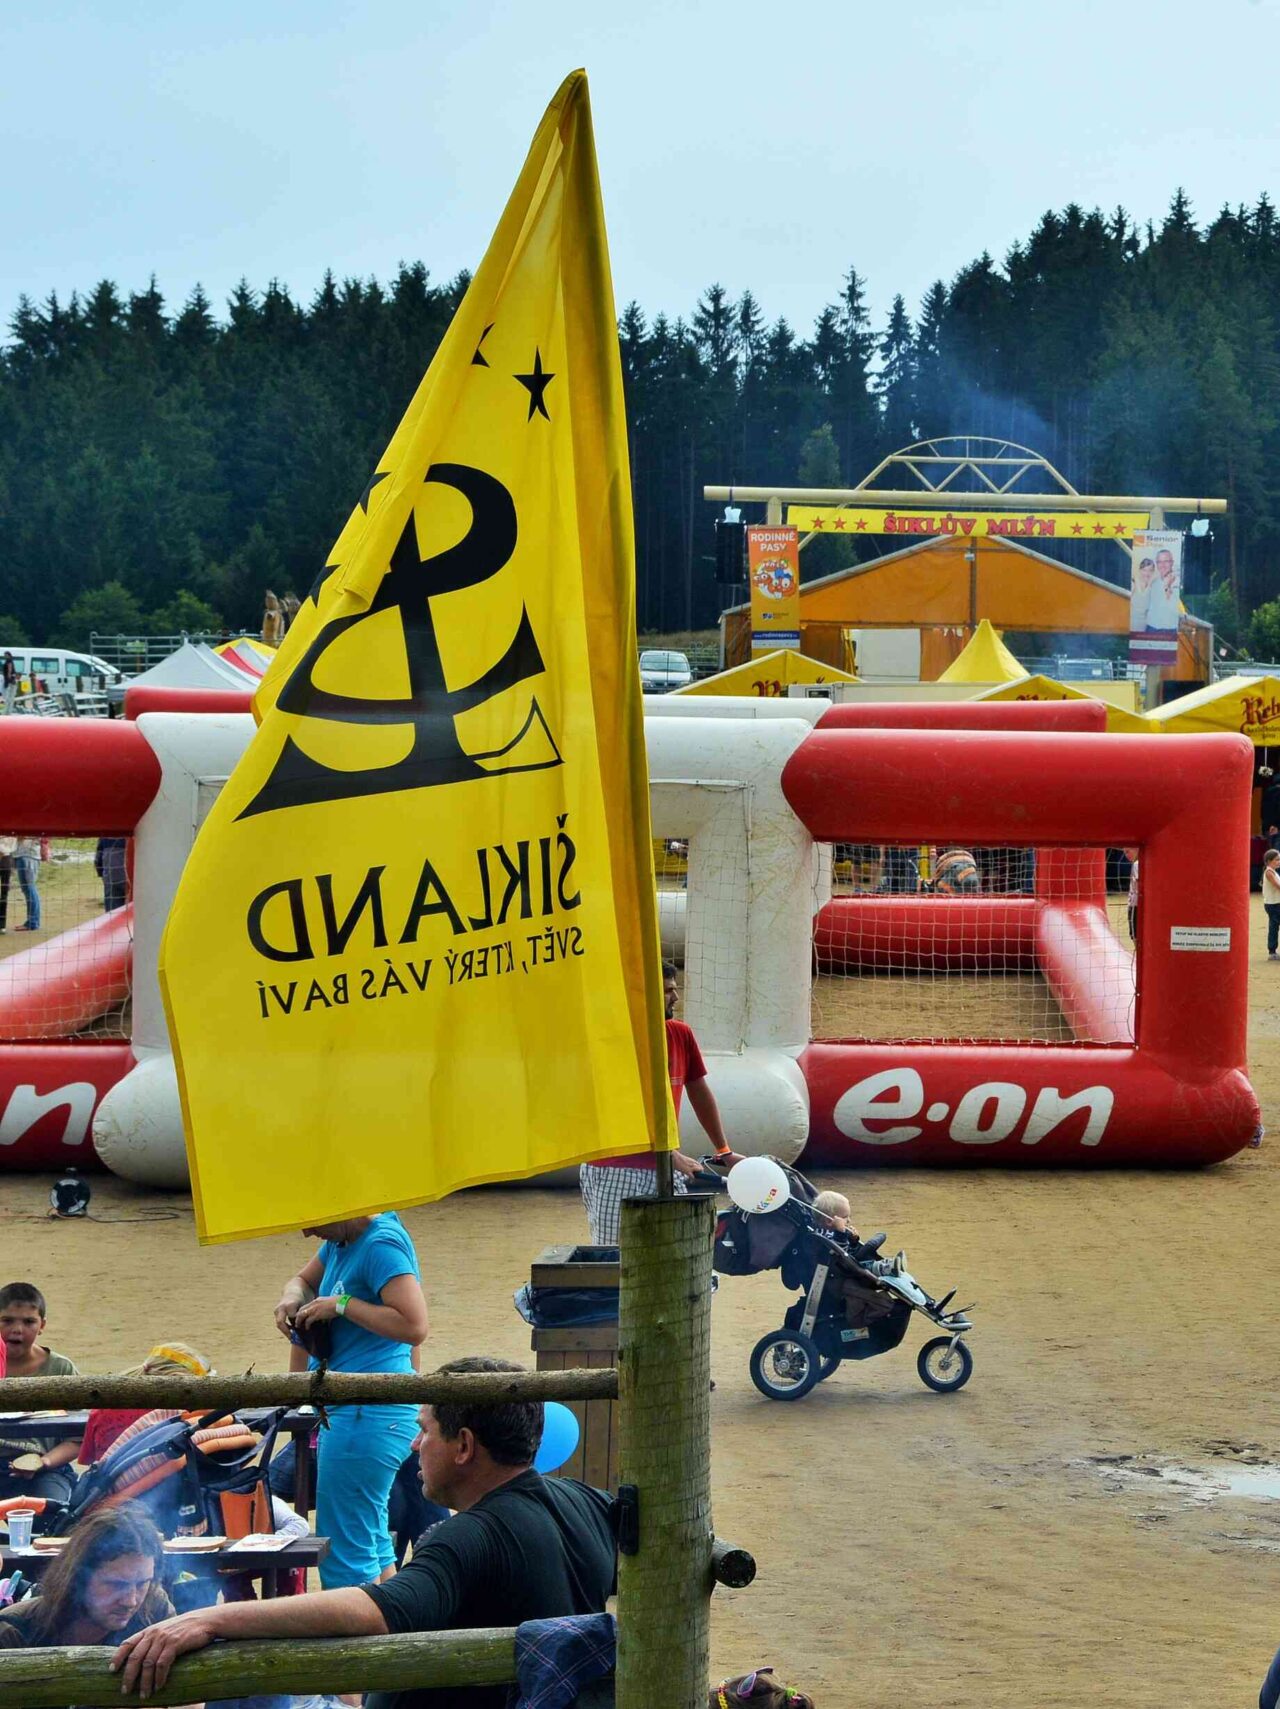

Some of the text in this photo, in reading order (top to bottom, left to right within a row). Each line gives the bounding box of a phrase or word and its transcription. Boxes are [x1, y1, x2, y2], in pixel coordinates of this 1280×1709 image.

[884, 512, 1056, 536] ŠIKLŮV MLÝN
[751, 532, 795, 542] RODINNÉ
[760, 543, 787, 552] PASY
